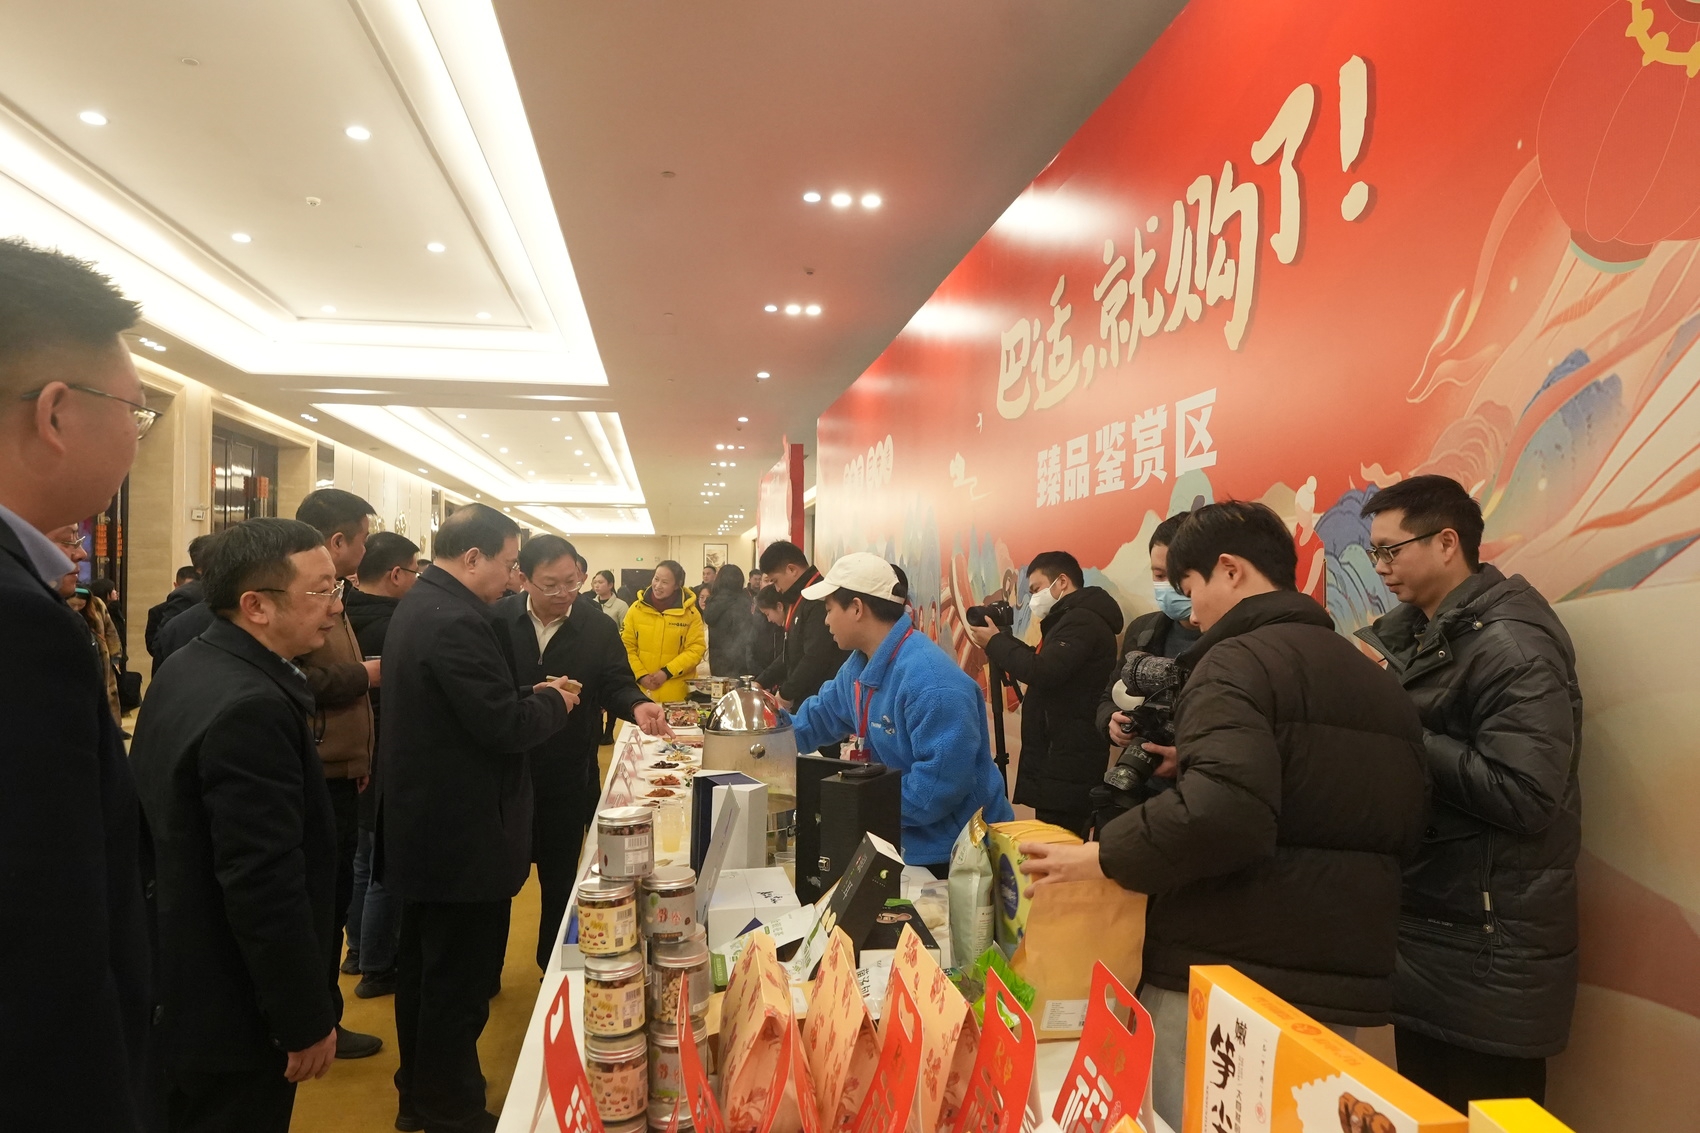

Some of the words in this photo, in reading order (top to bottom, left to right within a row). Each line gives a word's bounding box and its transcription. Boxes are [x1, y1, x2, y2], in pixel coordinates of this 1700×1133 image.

[1036, 387, 1218, 509] 臻品鉴赏区
